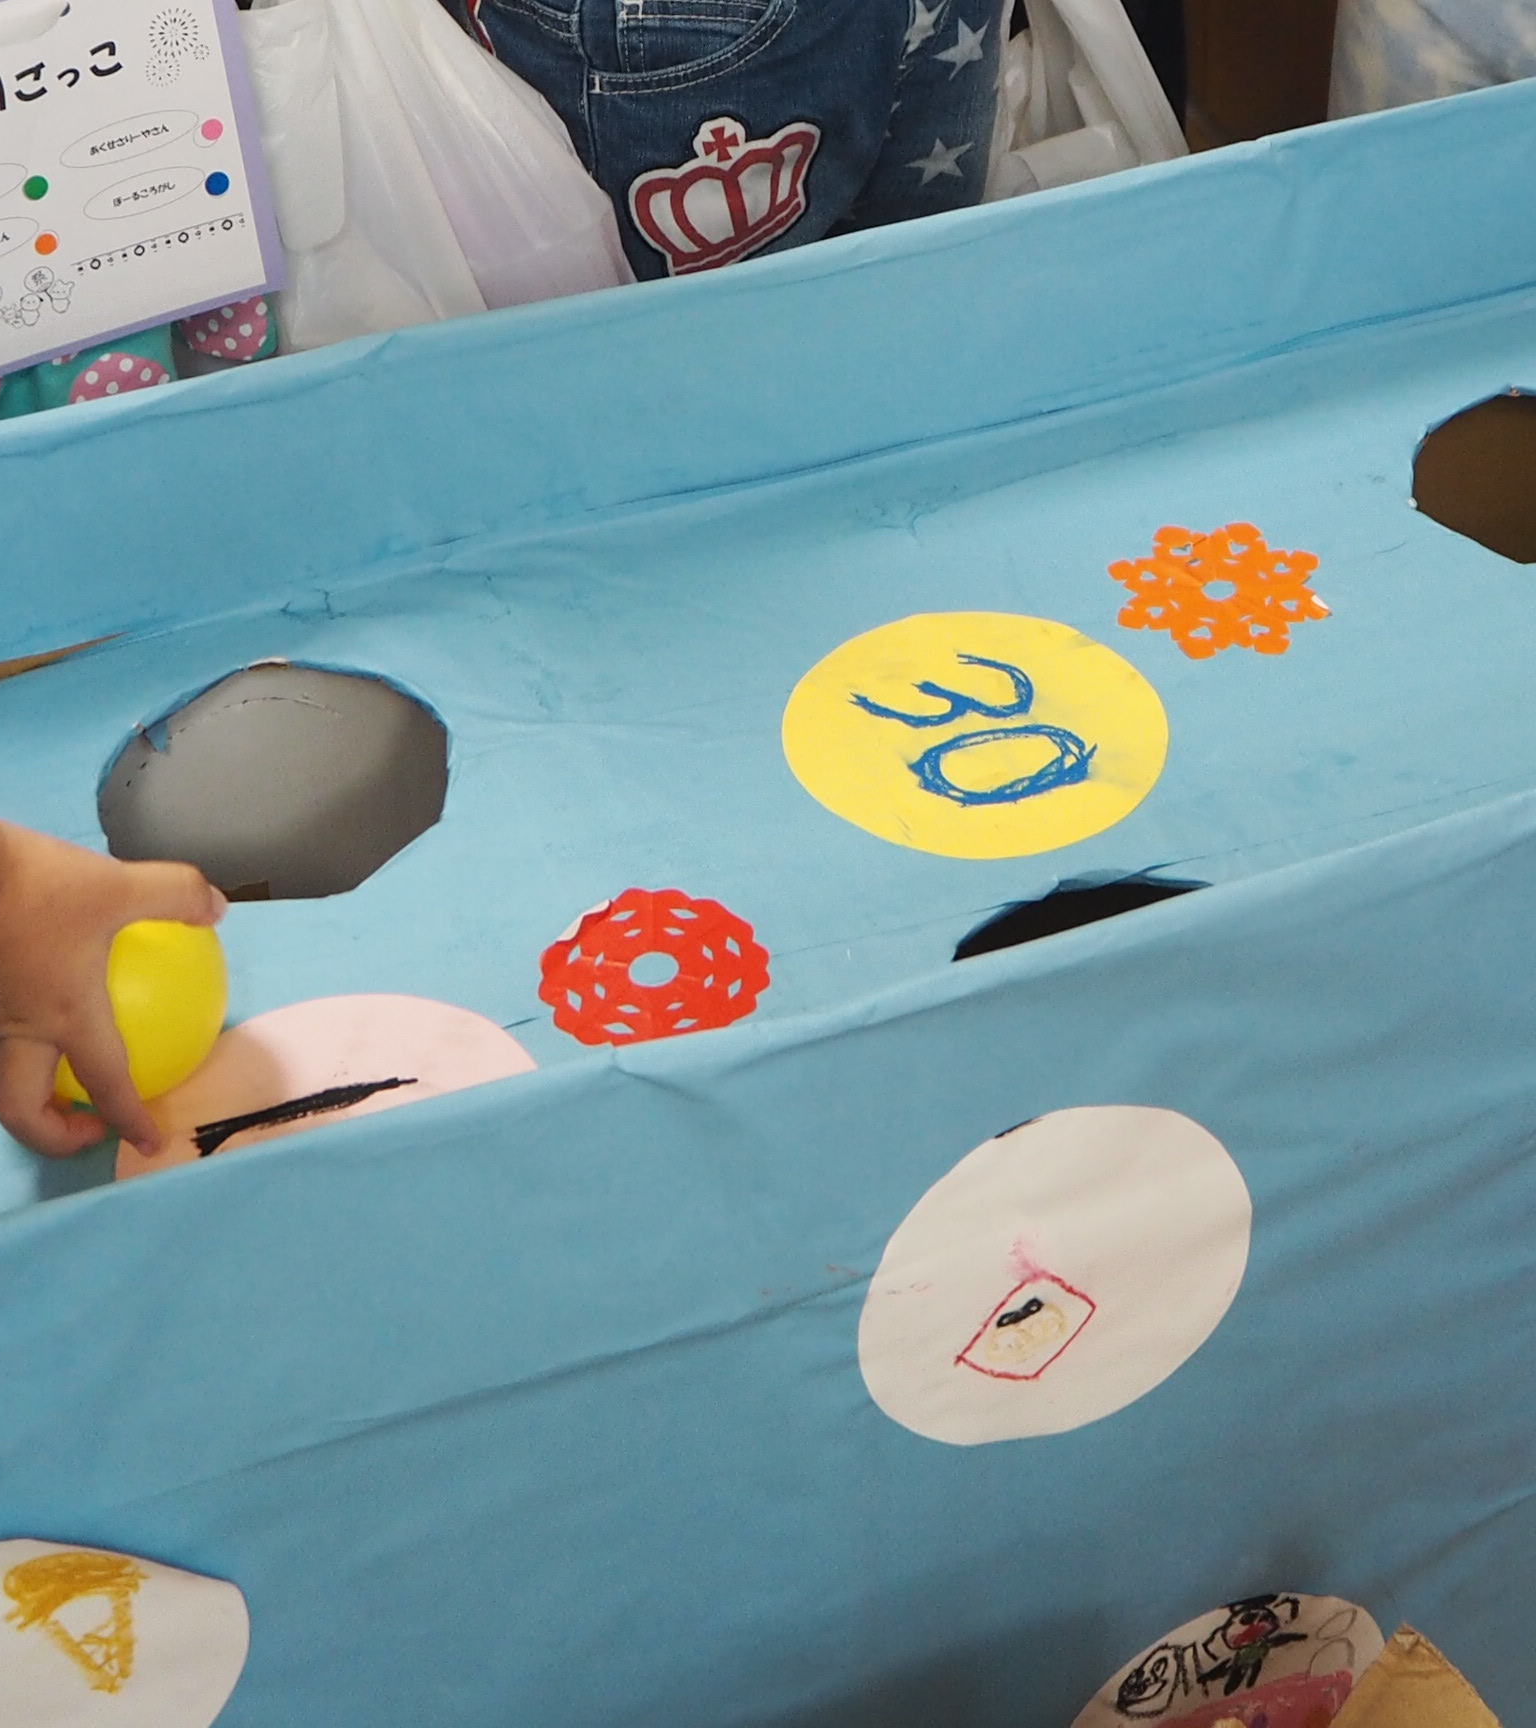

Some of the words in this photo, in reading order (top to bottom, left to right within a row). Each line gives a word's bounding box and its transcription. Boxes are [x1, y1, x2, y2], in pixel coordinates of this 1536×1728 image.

[89, 124, 170, 156] あくせさりーやさん
[849, 653, 1098, 808] 30
